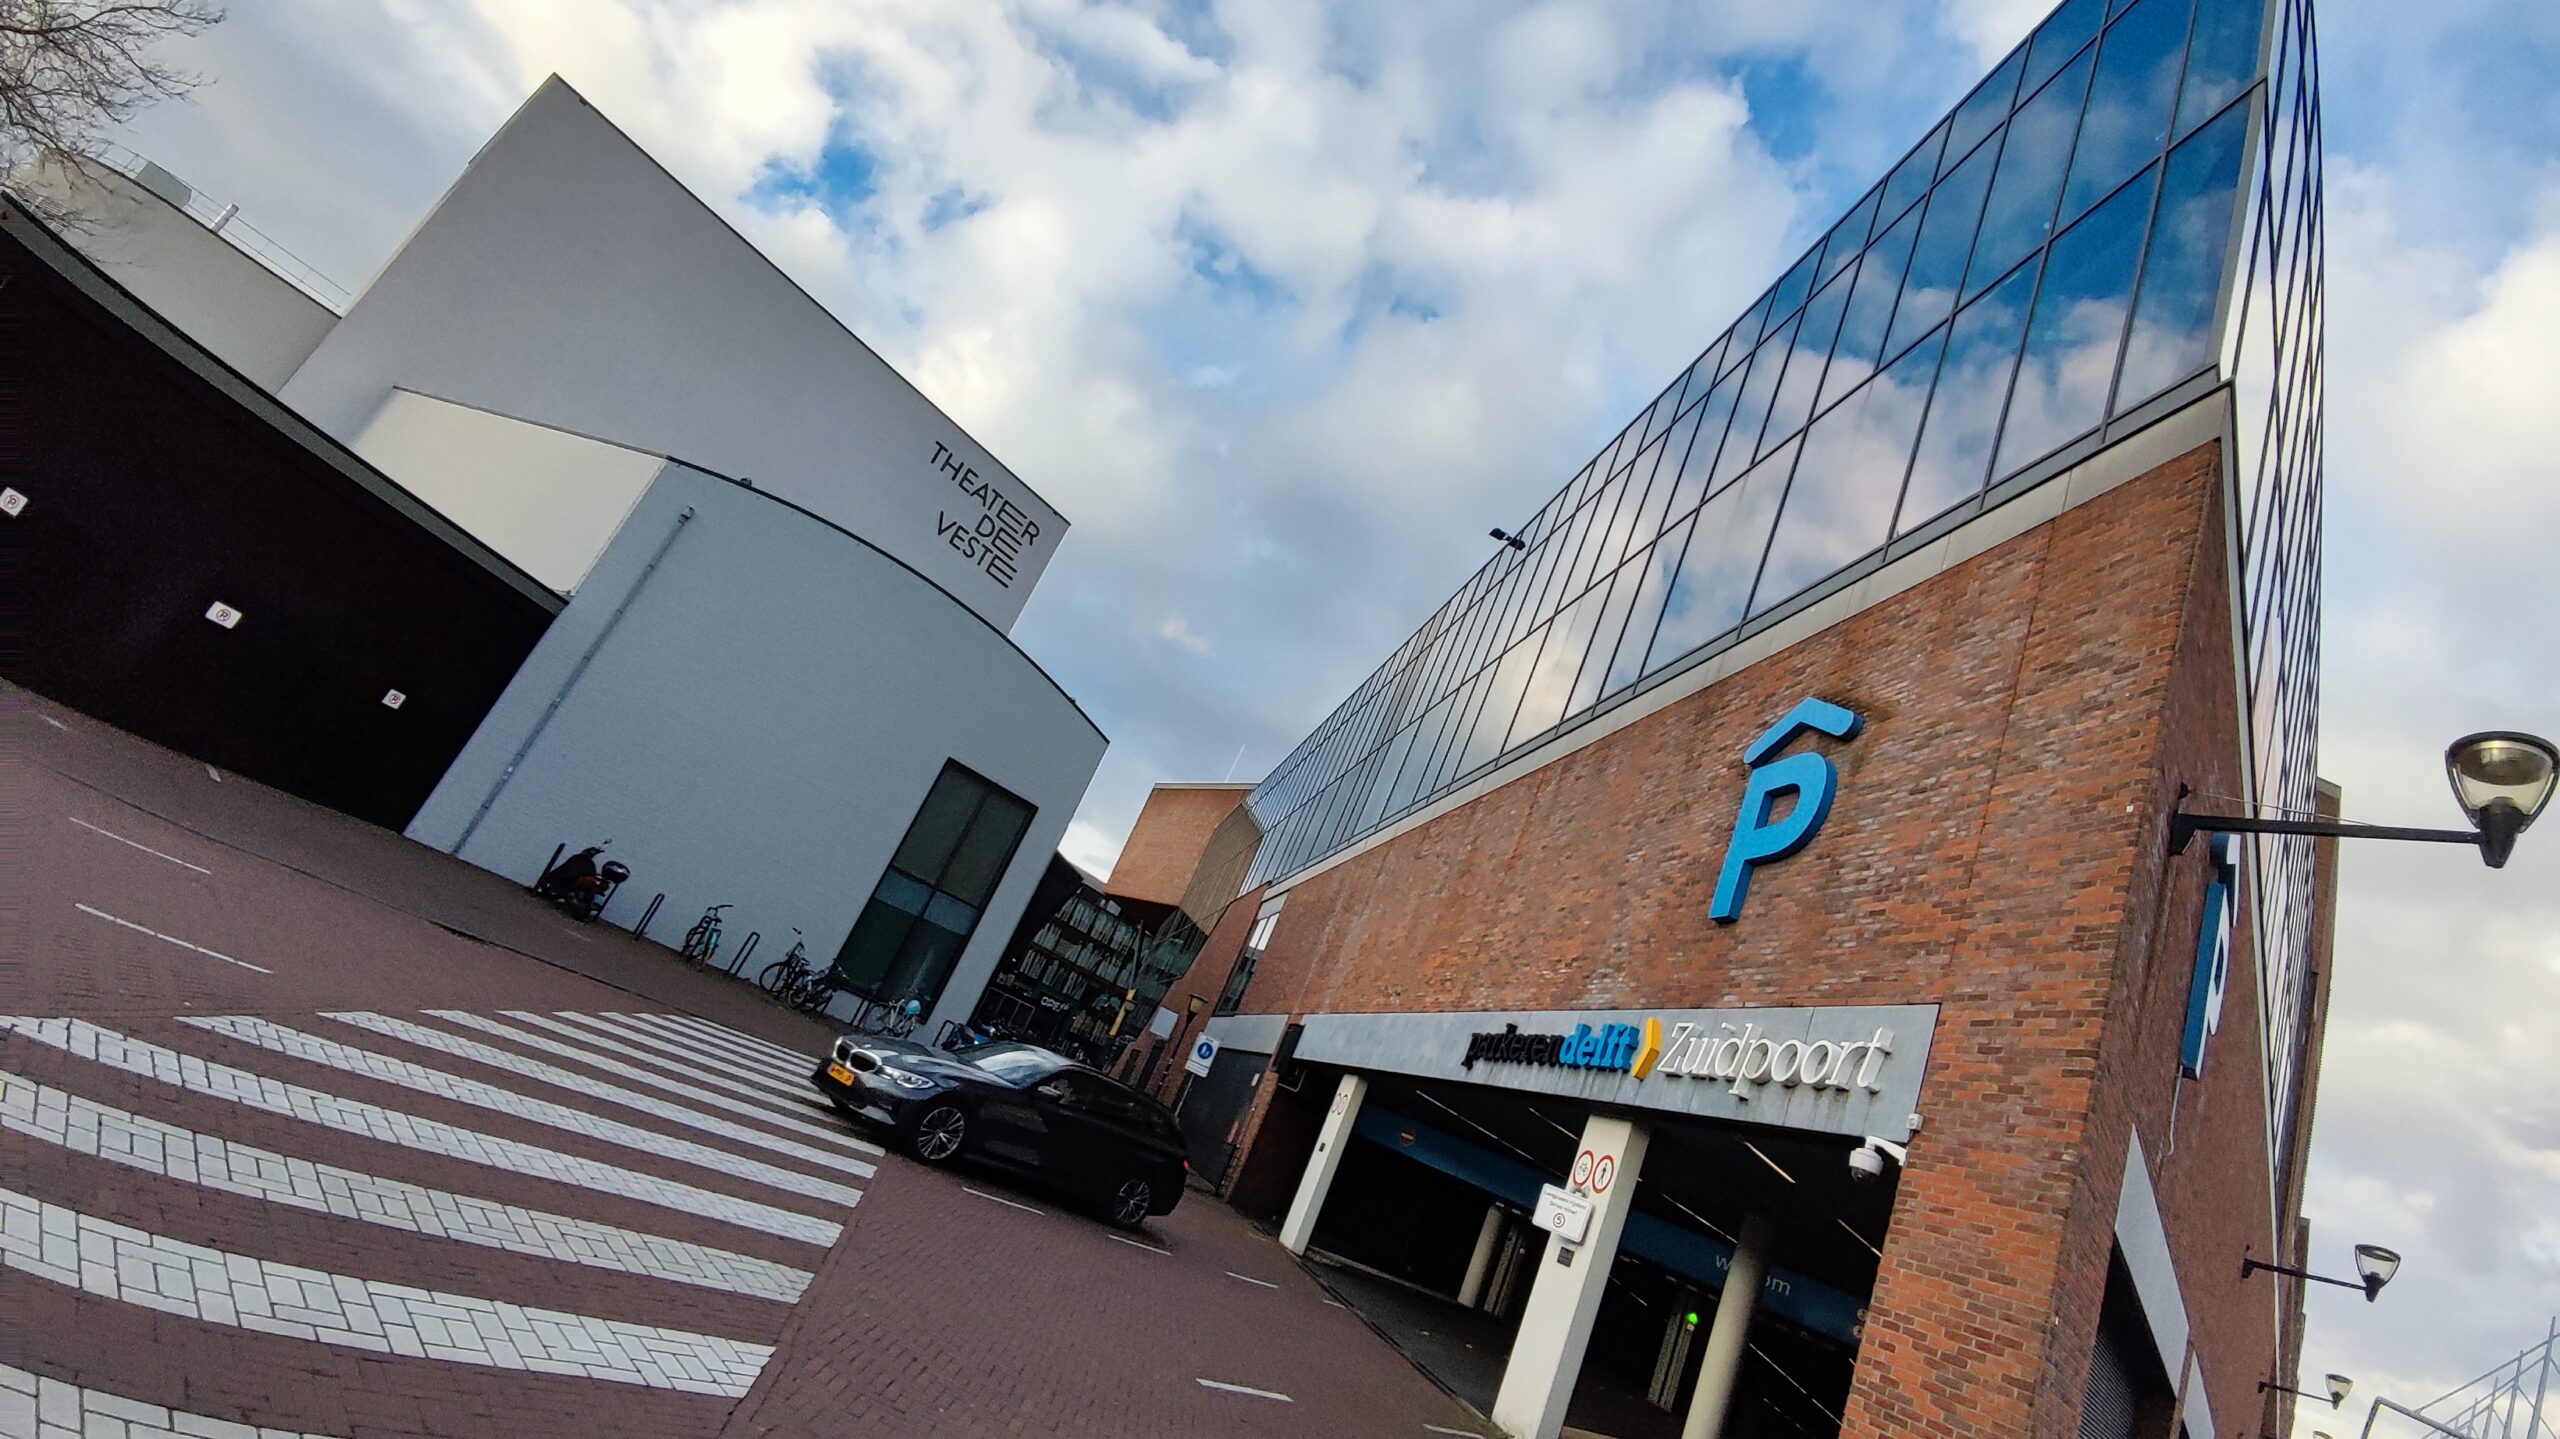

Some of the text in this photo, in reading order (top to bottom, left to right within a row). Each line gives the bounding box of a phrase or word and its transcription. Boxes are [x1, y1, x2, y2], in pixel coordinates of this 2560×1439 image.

[930, 440, 1041, 547] THEATER
[937, 510, 1018, 589] VESTE
[974, 512, 1023, 562] DE
[1708, 751, 1838, 925] P
[1657, 1022, 1894, 1101] Zuidpoort
